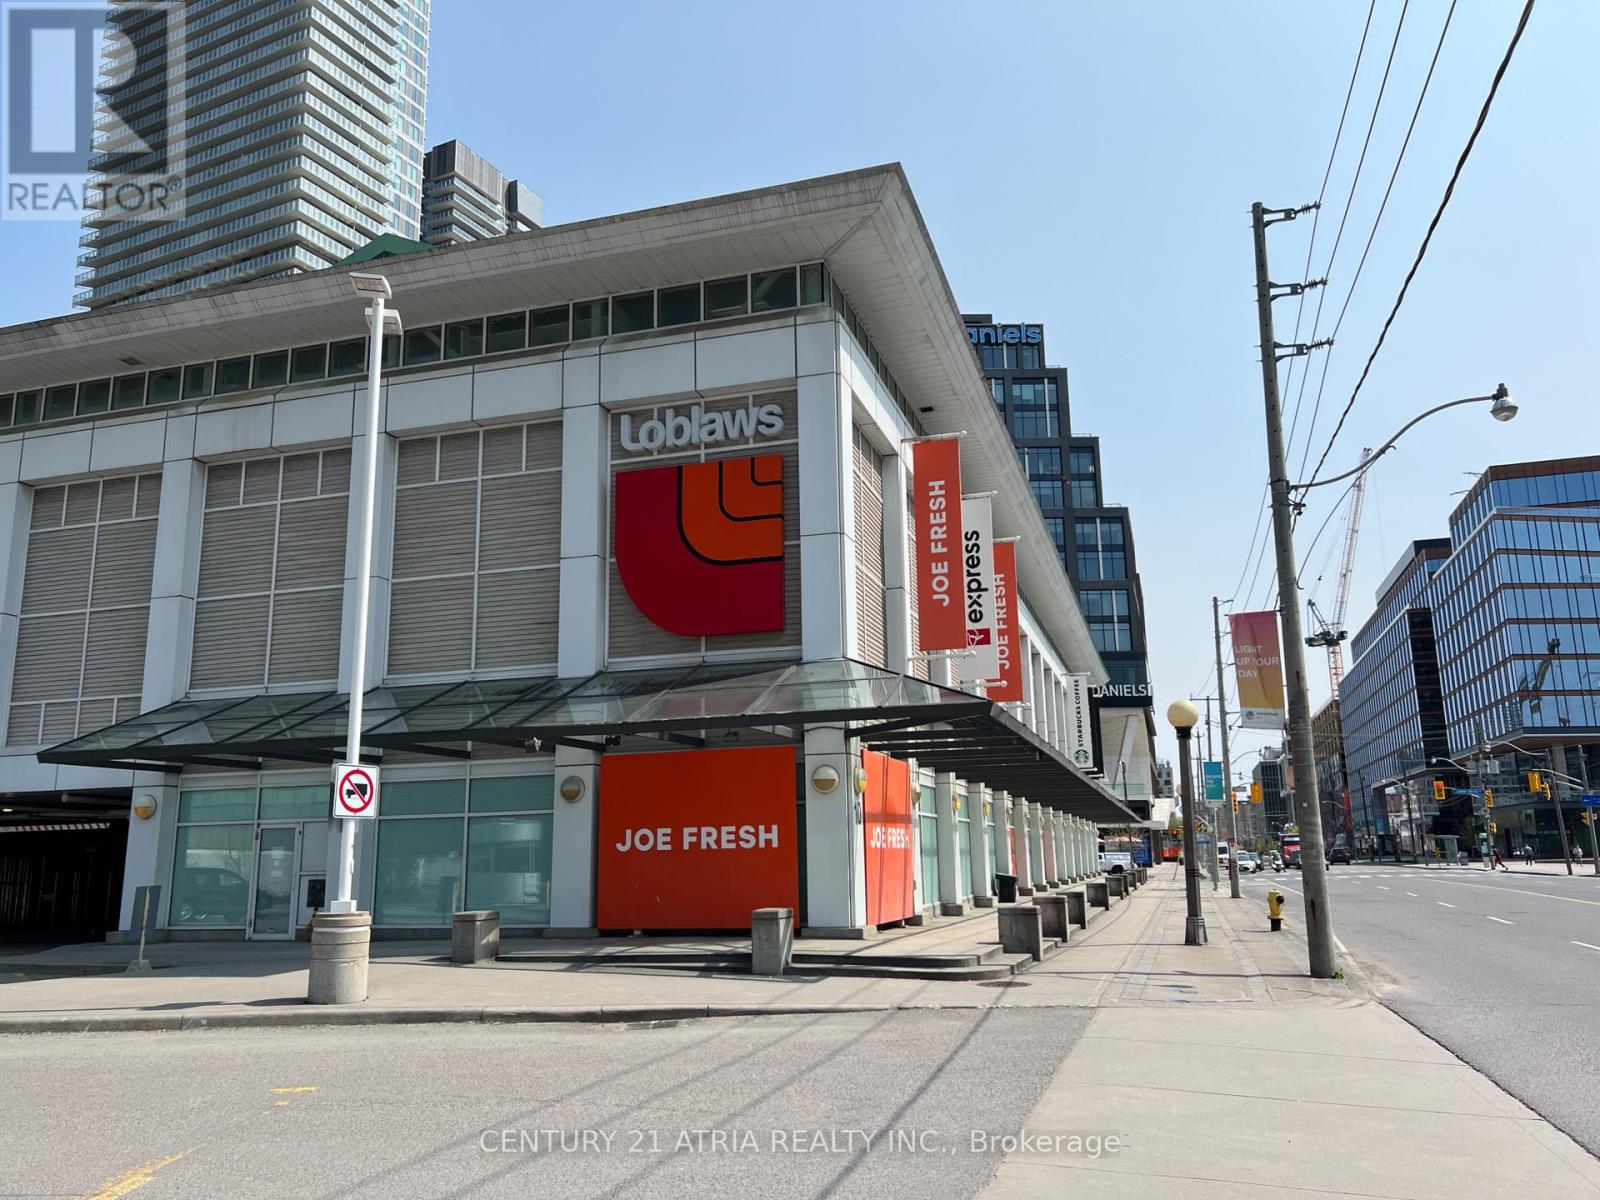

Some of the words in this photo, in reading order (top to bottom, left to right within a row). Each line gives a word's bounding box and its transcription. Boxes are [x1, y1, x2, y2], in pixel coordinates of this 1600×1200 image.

[620, 403, 785, 451] Loblaws
[929, 480, 948, 553] FRESH
[931, 560, 949, 607] JOE
[965, 530, 989, 624] express
[993, 573, 1006, 629] FRESH
[998, 634, 1010, 670] JOE
[1234, 645, 1263, 654] LIGHT
[1236, 657, 1250, 666] UP
[1238, 670, 1258, 678] DAY
[1075, 705, 1084, 748] STARBUCKS
[616, 828, 672, 852] JOE
[683, 824, 779, 850] FRESH
[870, 825, 886, 849] JOE
[887, 827, 910, 849] FRESH
